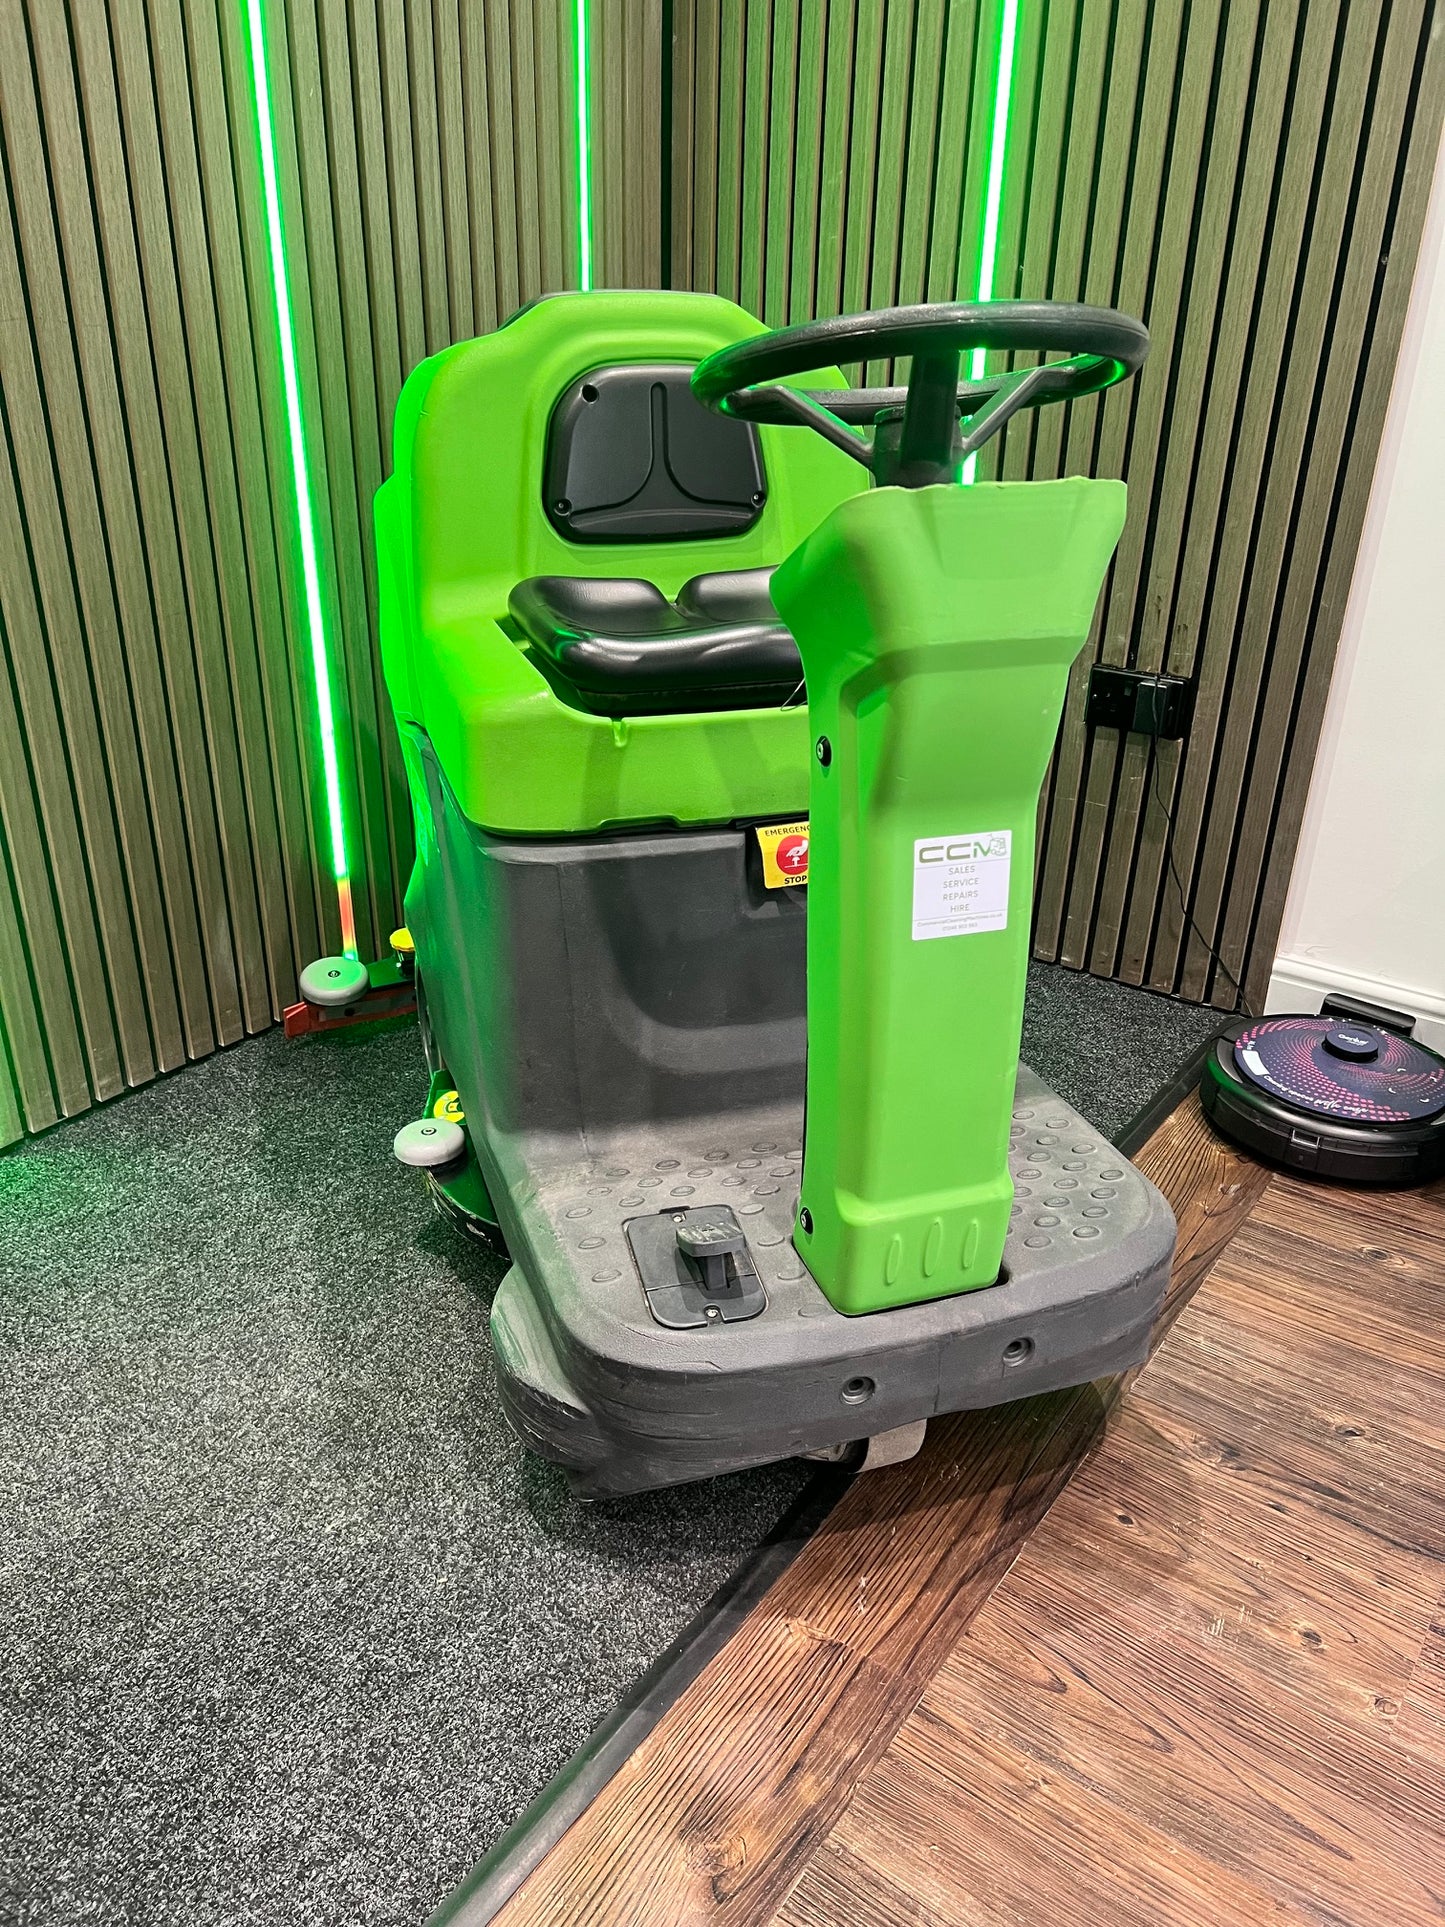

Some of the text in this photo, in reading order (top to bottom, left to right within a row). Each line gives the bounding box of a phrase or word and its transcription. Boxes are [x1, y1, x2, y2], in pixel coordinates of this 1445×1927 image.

[765, 825, 809, 837] EMERGENC
[948, 865, 976, 875] SALES
[785, 875, 807, 885] STOP
[943, 877, 979, 889] SERVICE
[943, 890, 979, 901] REPAIRS
[950, 904, 970, 913] HIRE
